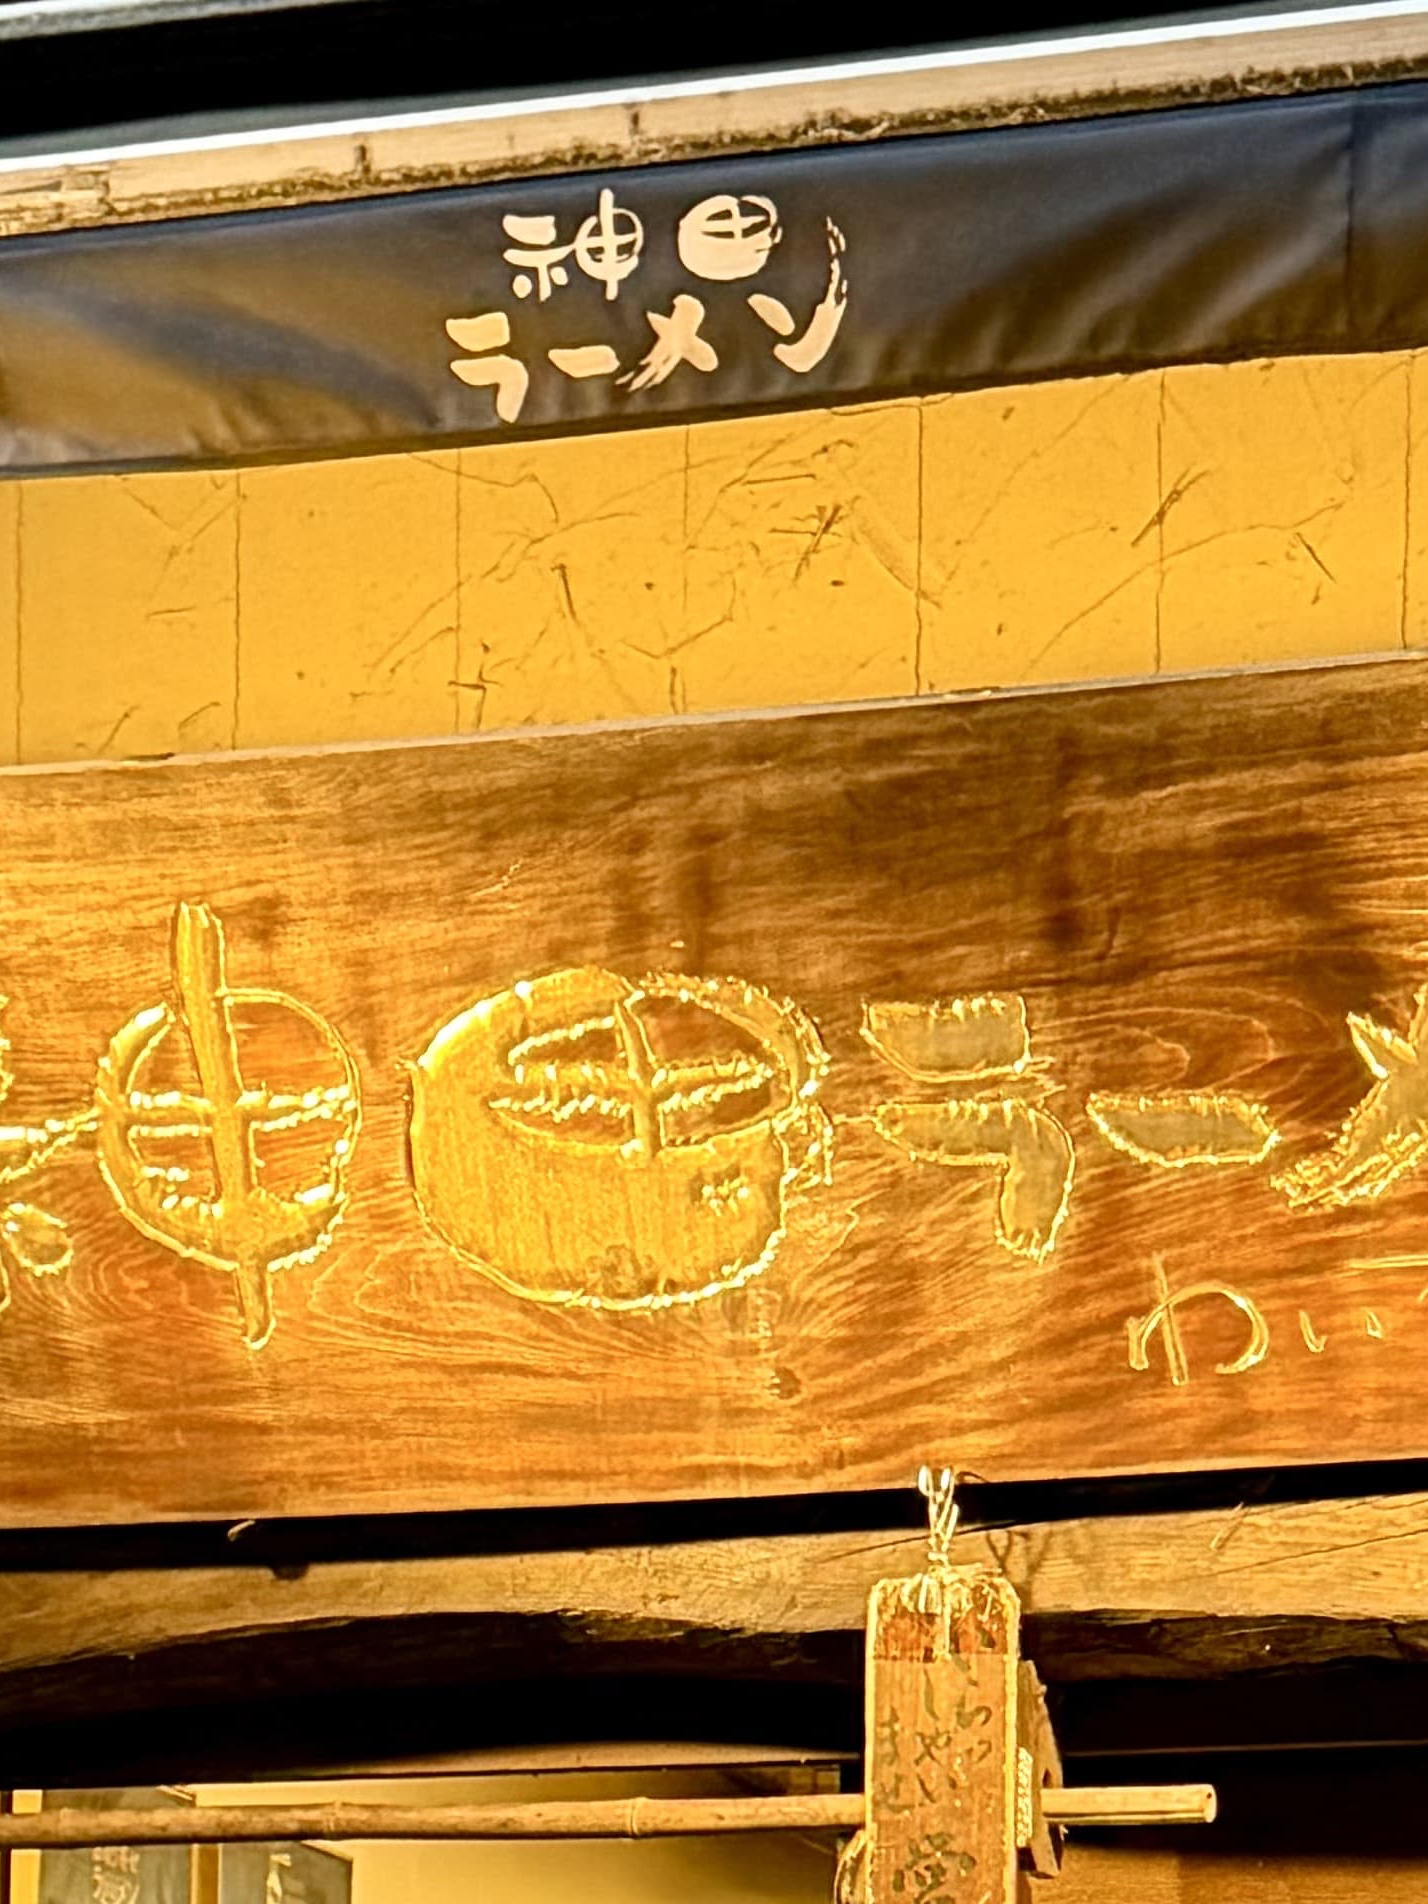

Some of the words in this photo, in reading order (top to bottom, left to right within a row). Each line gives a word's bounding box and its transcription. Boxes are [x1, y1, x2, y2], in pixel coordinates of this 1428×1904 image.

[445, 215, 848, 424] ラーメン
[502, 188, 784, 301] 神田
